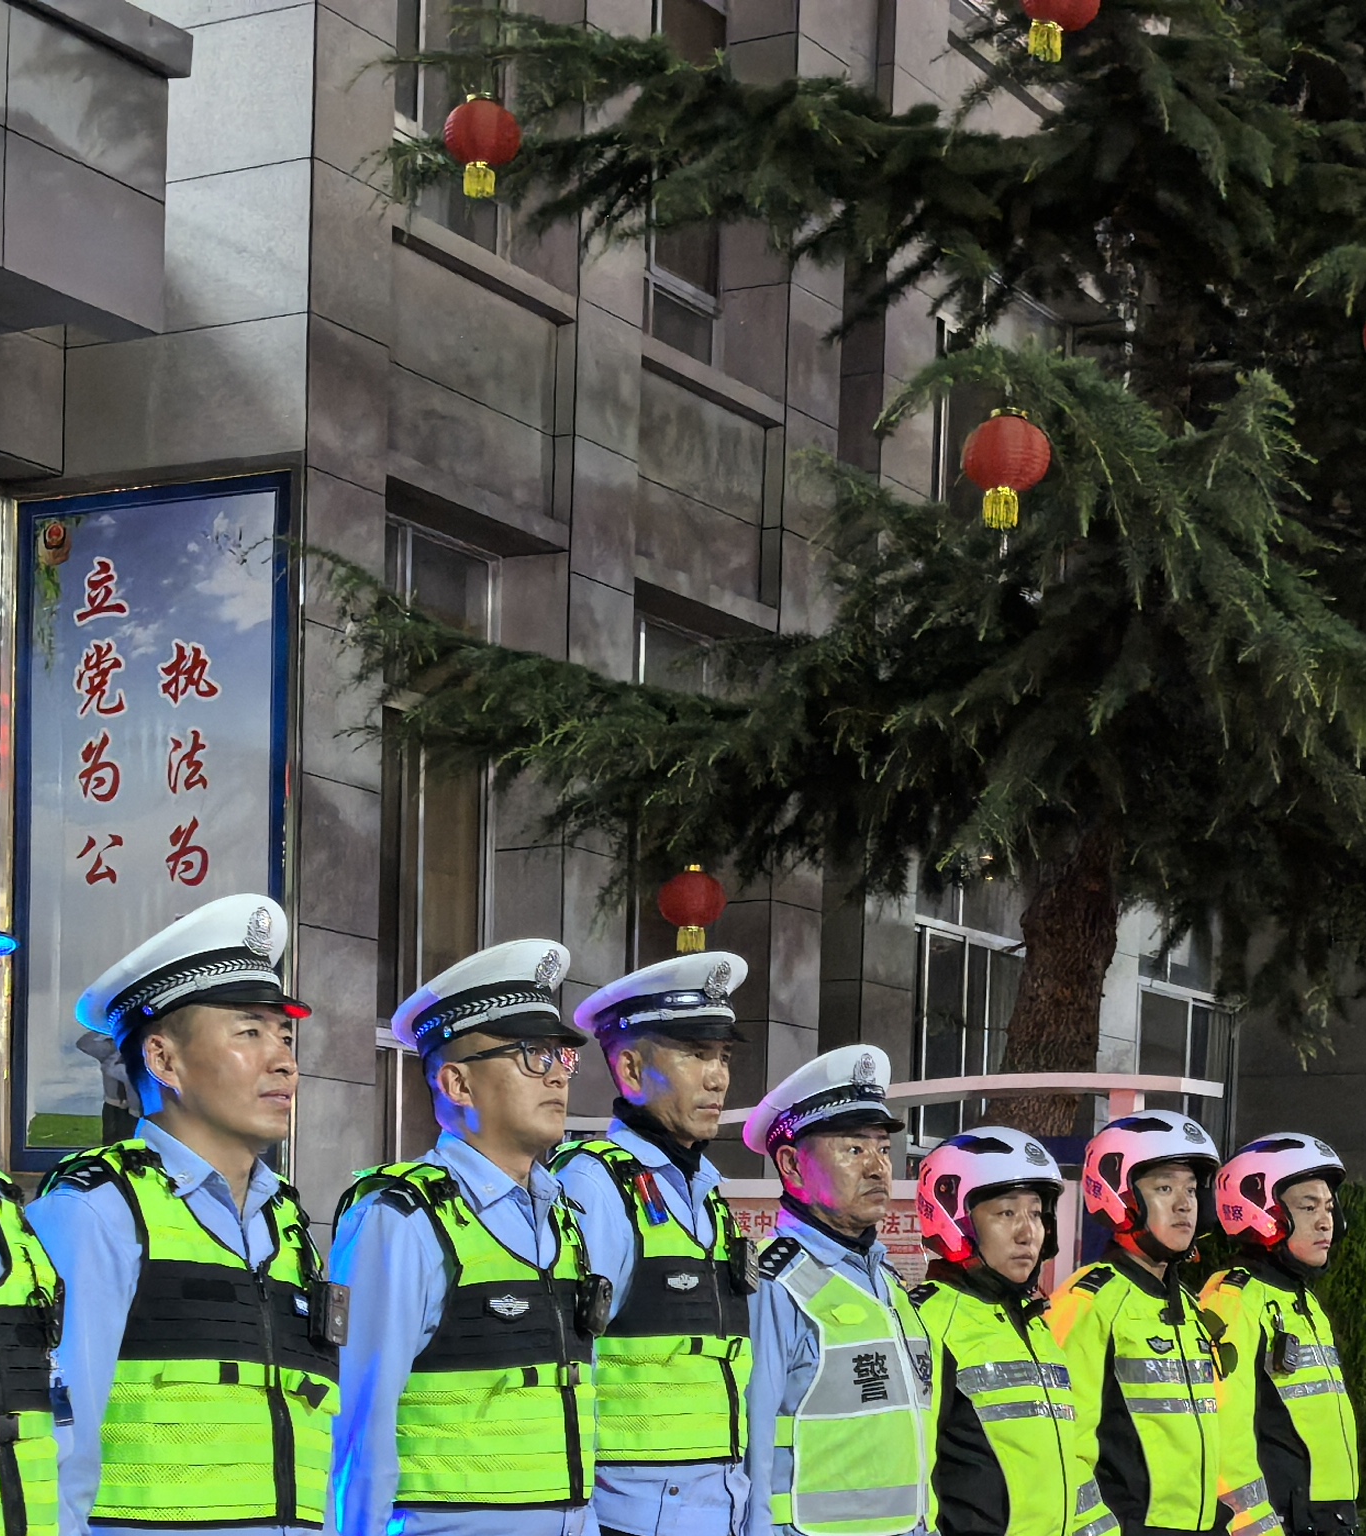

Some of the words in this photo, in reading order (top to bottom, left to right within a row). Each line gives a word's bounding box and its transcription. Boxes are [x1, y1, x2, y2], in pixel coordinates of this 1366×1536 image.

[75, 560, 128, 887] 立党为公
[159, 640, 220, 920] 执法为
